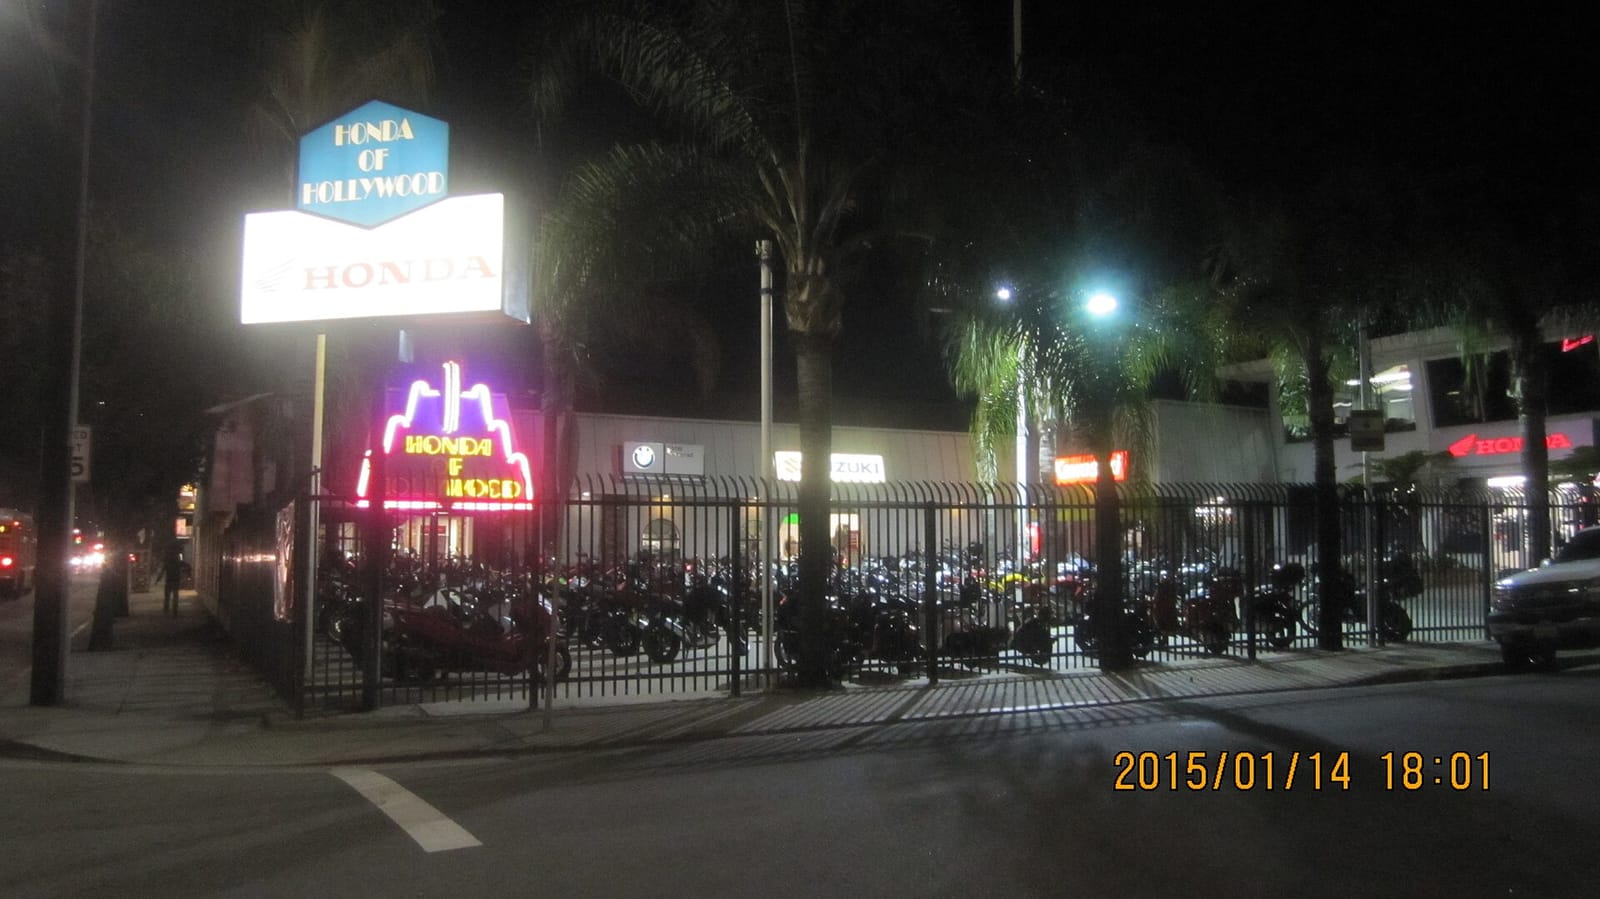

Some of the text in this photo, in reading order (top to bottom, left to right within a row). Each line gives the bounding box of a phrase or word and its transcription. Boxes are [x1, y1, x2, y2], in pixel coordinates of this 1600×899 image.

[334, 118, 415, 147] HONDA
[357, 148, 389, 172] OF
[302, 171, 446, 205] HOLLYWOOD
[303, 256, 497, 291] HONDA
[405, 435, 492, 456] HONDA
